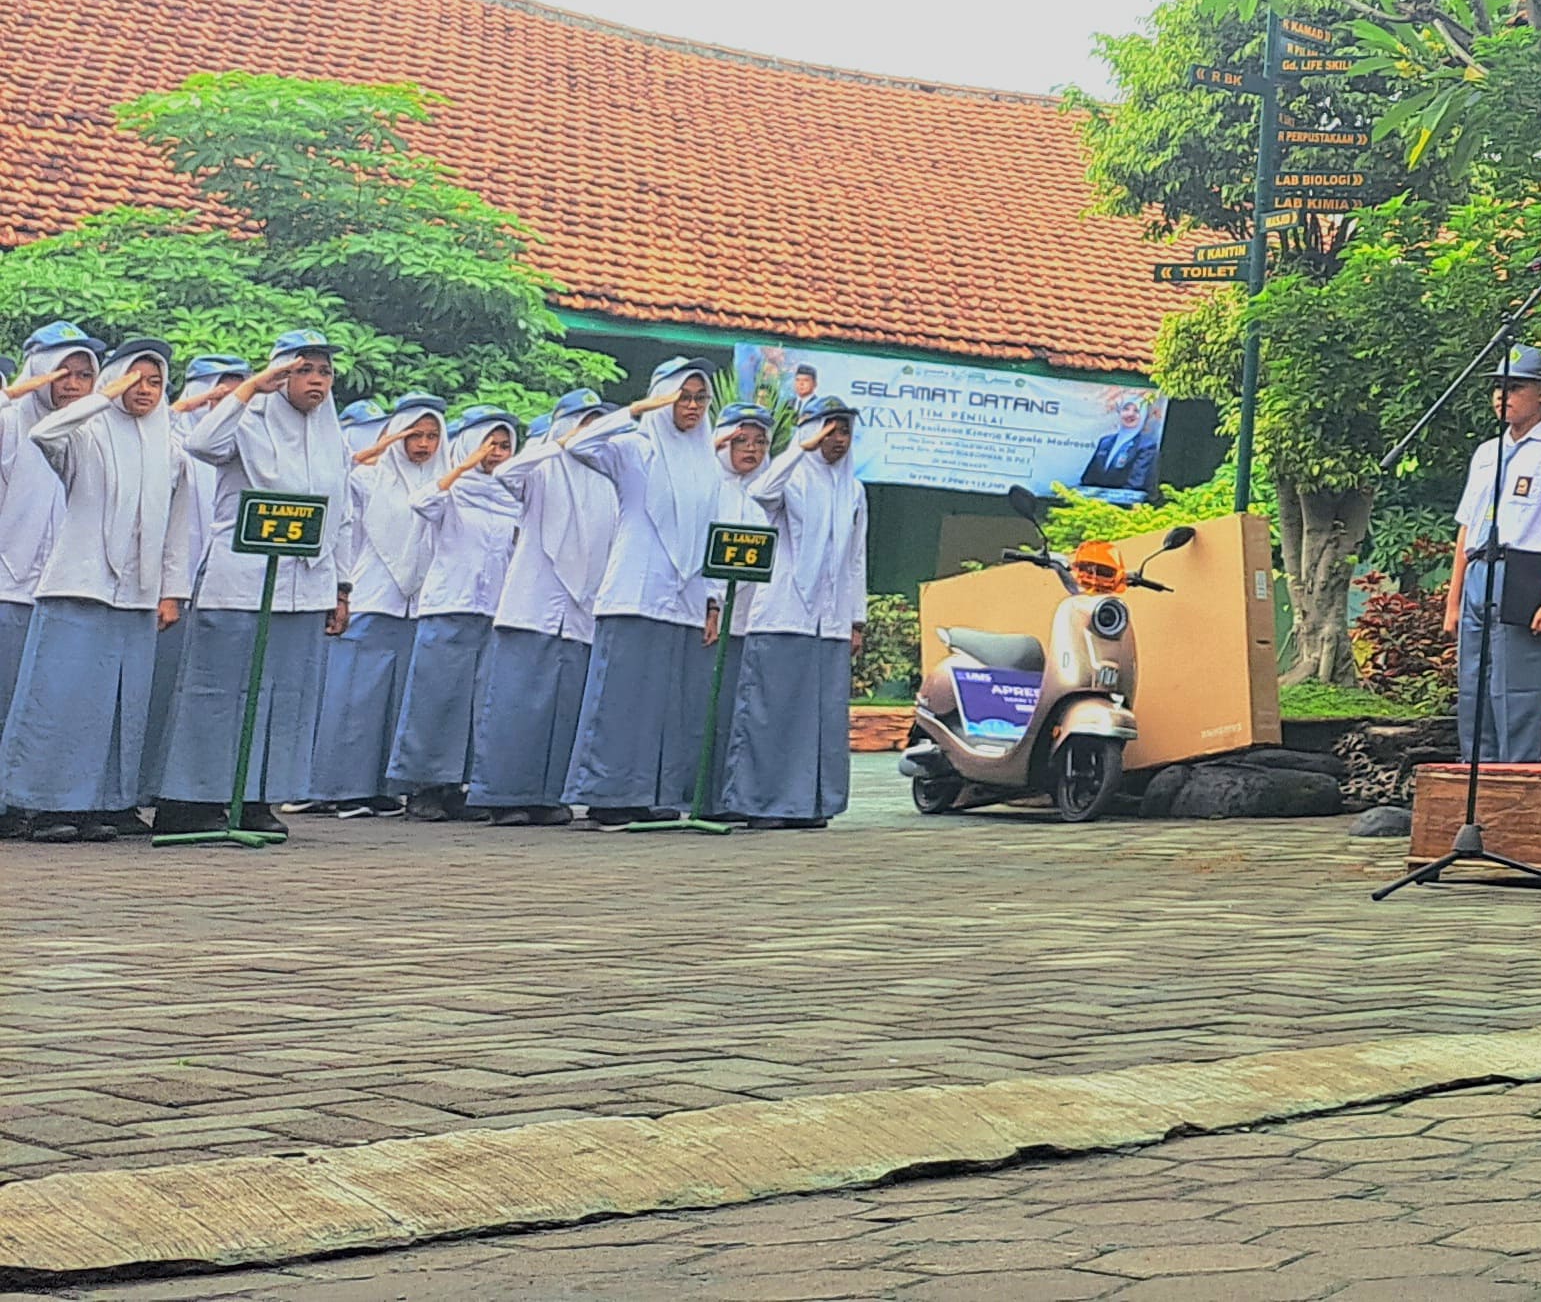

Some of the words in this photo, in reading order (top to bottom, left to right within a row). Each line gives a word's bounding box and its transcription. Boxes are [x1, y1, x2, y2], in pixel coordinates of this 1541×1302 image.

[1282, 60, 1298, 71] Gd.
[1301, 60, 1323, 71] LIFE
[1212, 70, 1221, 83] R
[1224, 72, 1243, 86] BK
[1286, 131, 1354, 145] PERPUSTAKAAN
[1275, 175, 1299, 186] LAB
[1302, 175, 1351, 186] BIOLOGI
[1275, 198, 1303, 209] LAB
[1307, 199, 1349, 210] KIMIA
[1207, 244, 1247, 260] KANTIN
[1182, 265, 1238, 278] TOILET
[850, 380, 963, 405] SELAMAT
[967, 391, 1061, 416] DATANG
[919, 408, 943, 419] TIM
[951, 411, 1005, 425] PENILAI
[1005, 433, 1043, 445] Kepala
[271, 505, 315, 518] LANJUT
[261, 519, 304, 543] F_5
[733, 533, 768, 547] LANJUT
[724, 545, 758, 566] F_6
